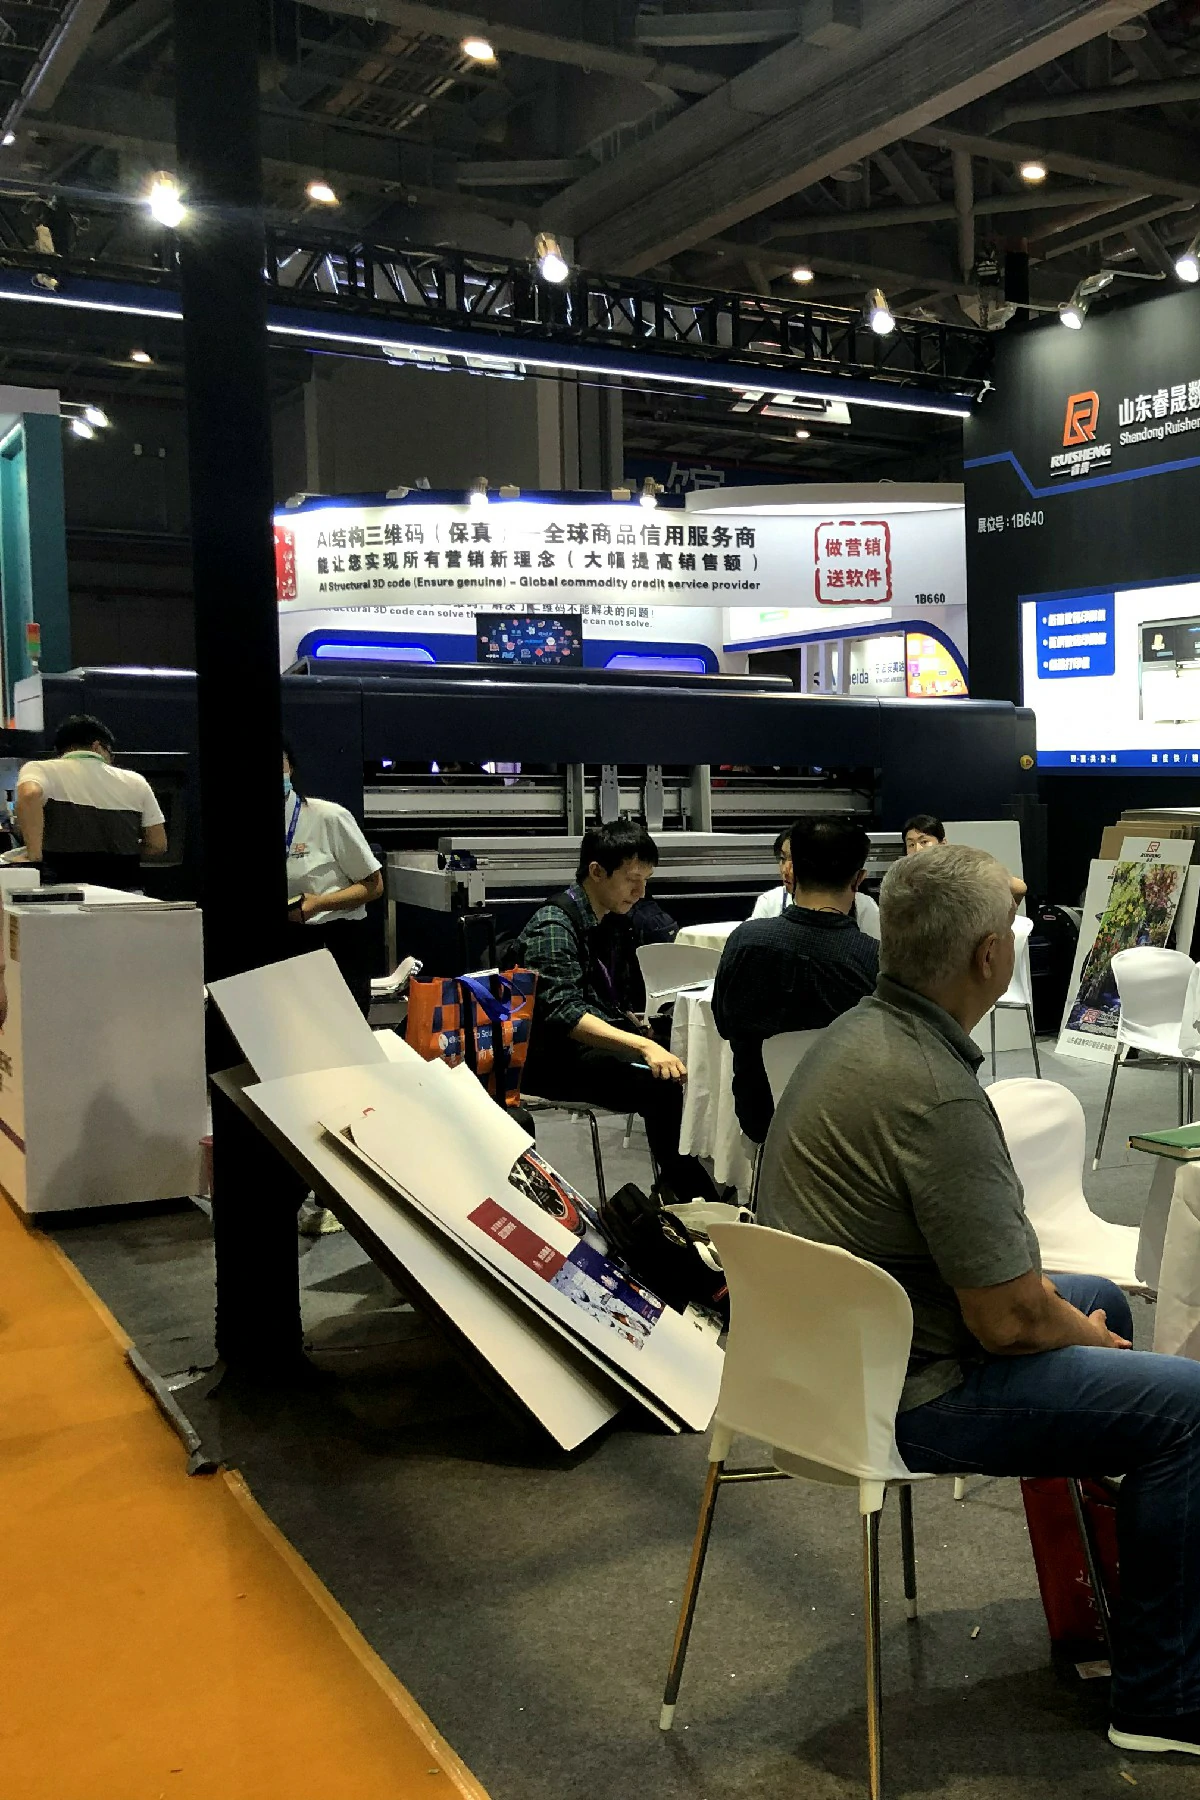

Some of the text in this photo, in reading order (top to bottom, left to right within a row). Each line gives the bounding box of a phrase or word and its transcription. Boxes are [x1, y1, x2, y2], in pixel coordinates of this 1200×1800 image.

[1120, 427, 1164, 445] Shandong
[1050, 443, 1112, 469] RUISHENG
[825, 537, 882, 557] 做营销
[328, 578, 371, 592] Structural
[372, 577, 385, 589] 3D
[387, 576, 411, 588] code
[414, 576, 454, 588] (Ensure
[457, 575, 506, 589] genuine)
[519, 576, 558, 588] Global
[560, 577, 628, 590] commodity
[631, 577, 666, 589] credit
[668, 579, 709, 589] service
[712, 578, 761, 591] provider
[826, 568, 882, 588] 送软件
[915, 593, 946, 605] 1B660
[389, 607, 414, 615] code
[437, 609, 464, 618] solve
